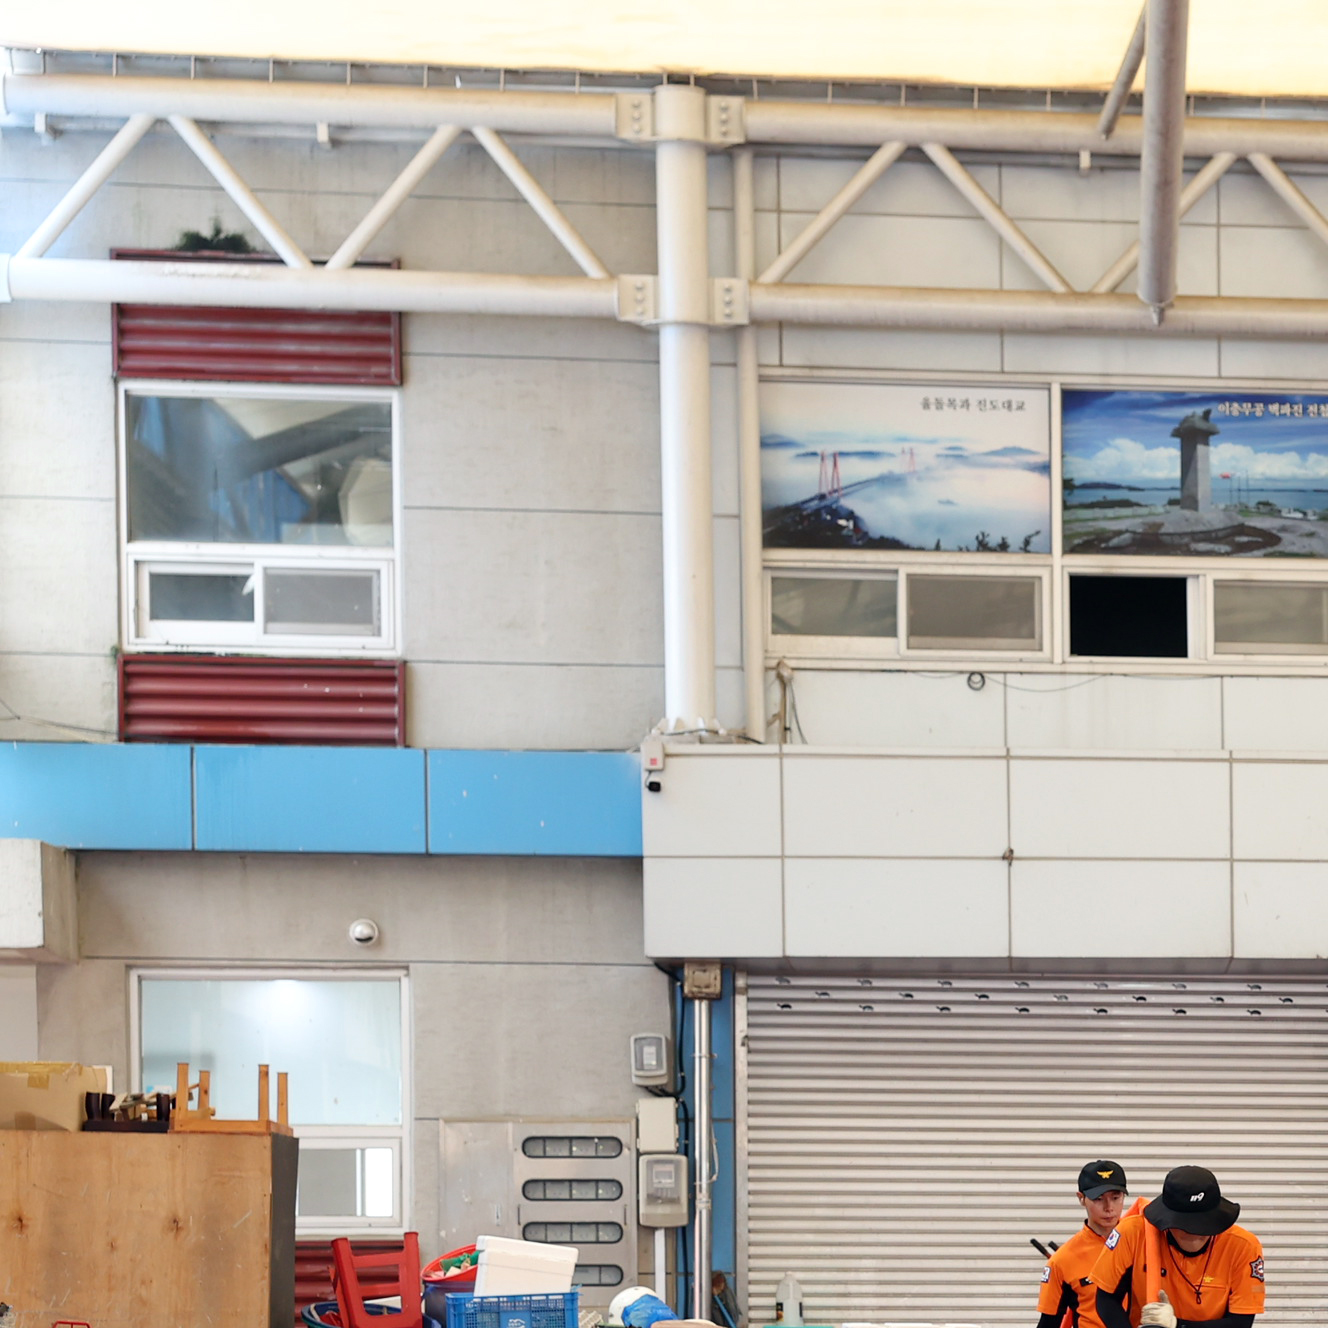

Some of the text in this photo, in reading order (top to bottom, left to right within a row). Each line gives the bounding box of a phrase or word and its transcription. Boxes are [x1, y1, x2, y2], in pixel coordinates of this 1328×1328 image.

[921, 396, 1026, 412] 울돌목과 진도대교
[1217, 401, 1265, 418] 이충무공
[1268, 402, 1304, 418] 벽파진
[1190, 1192, 1205, 1202] 119
